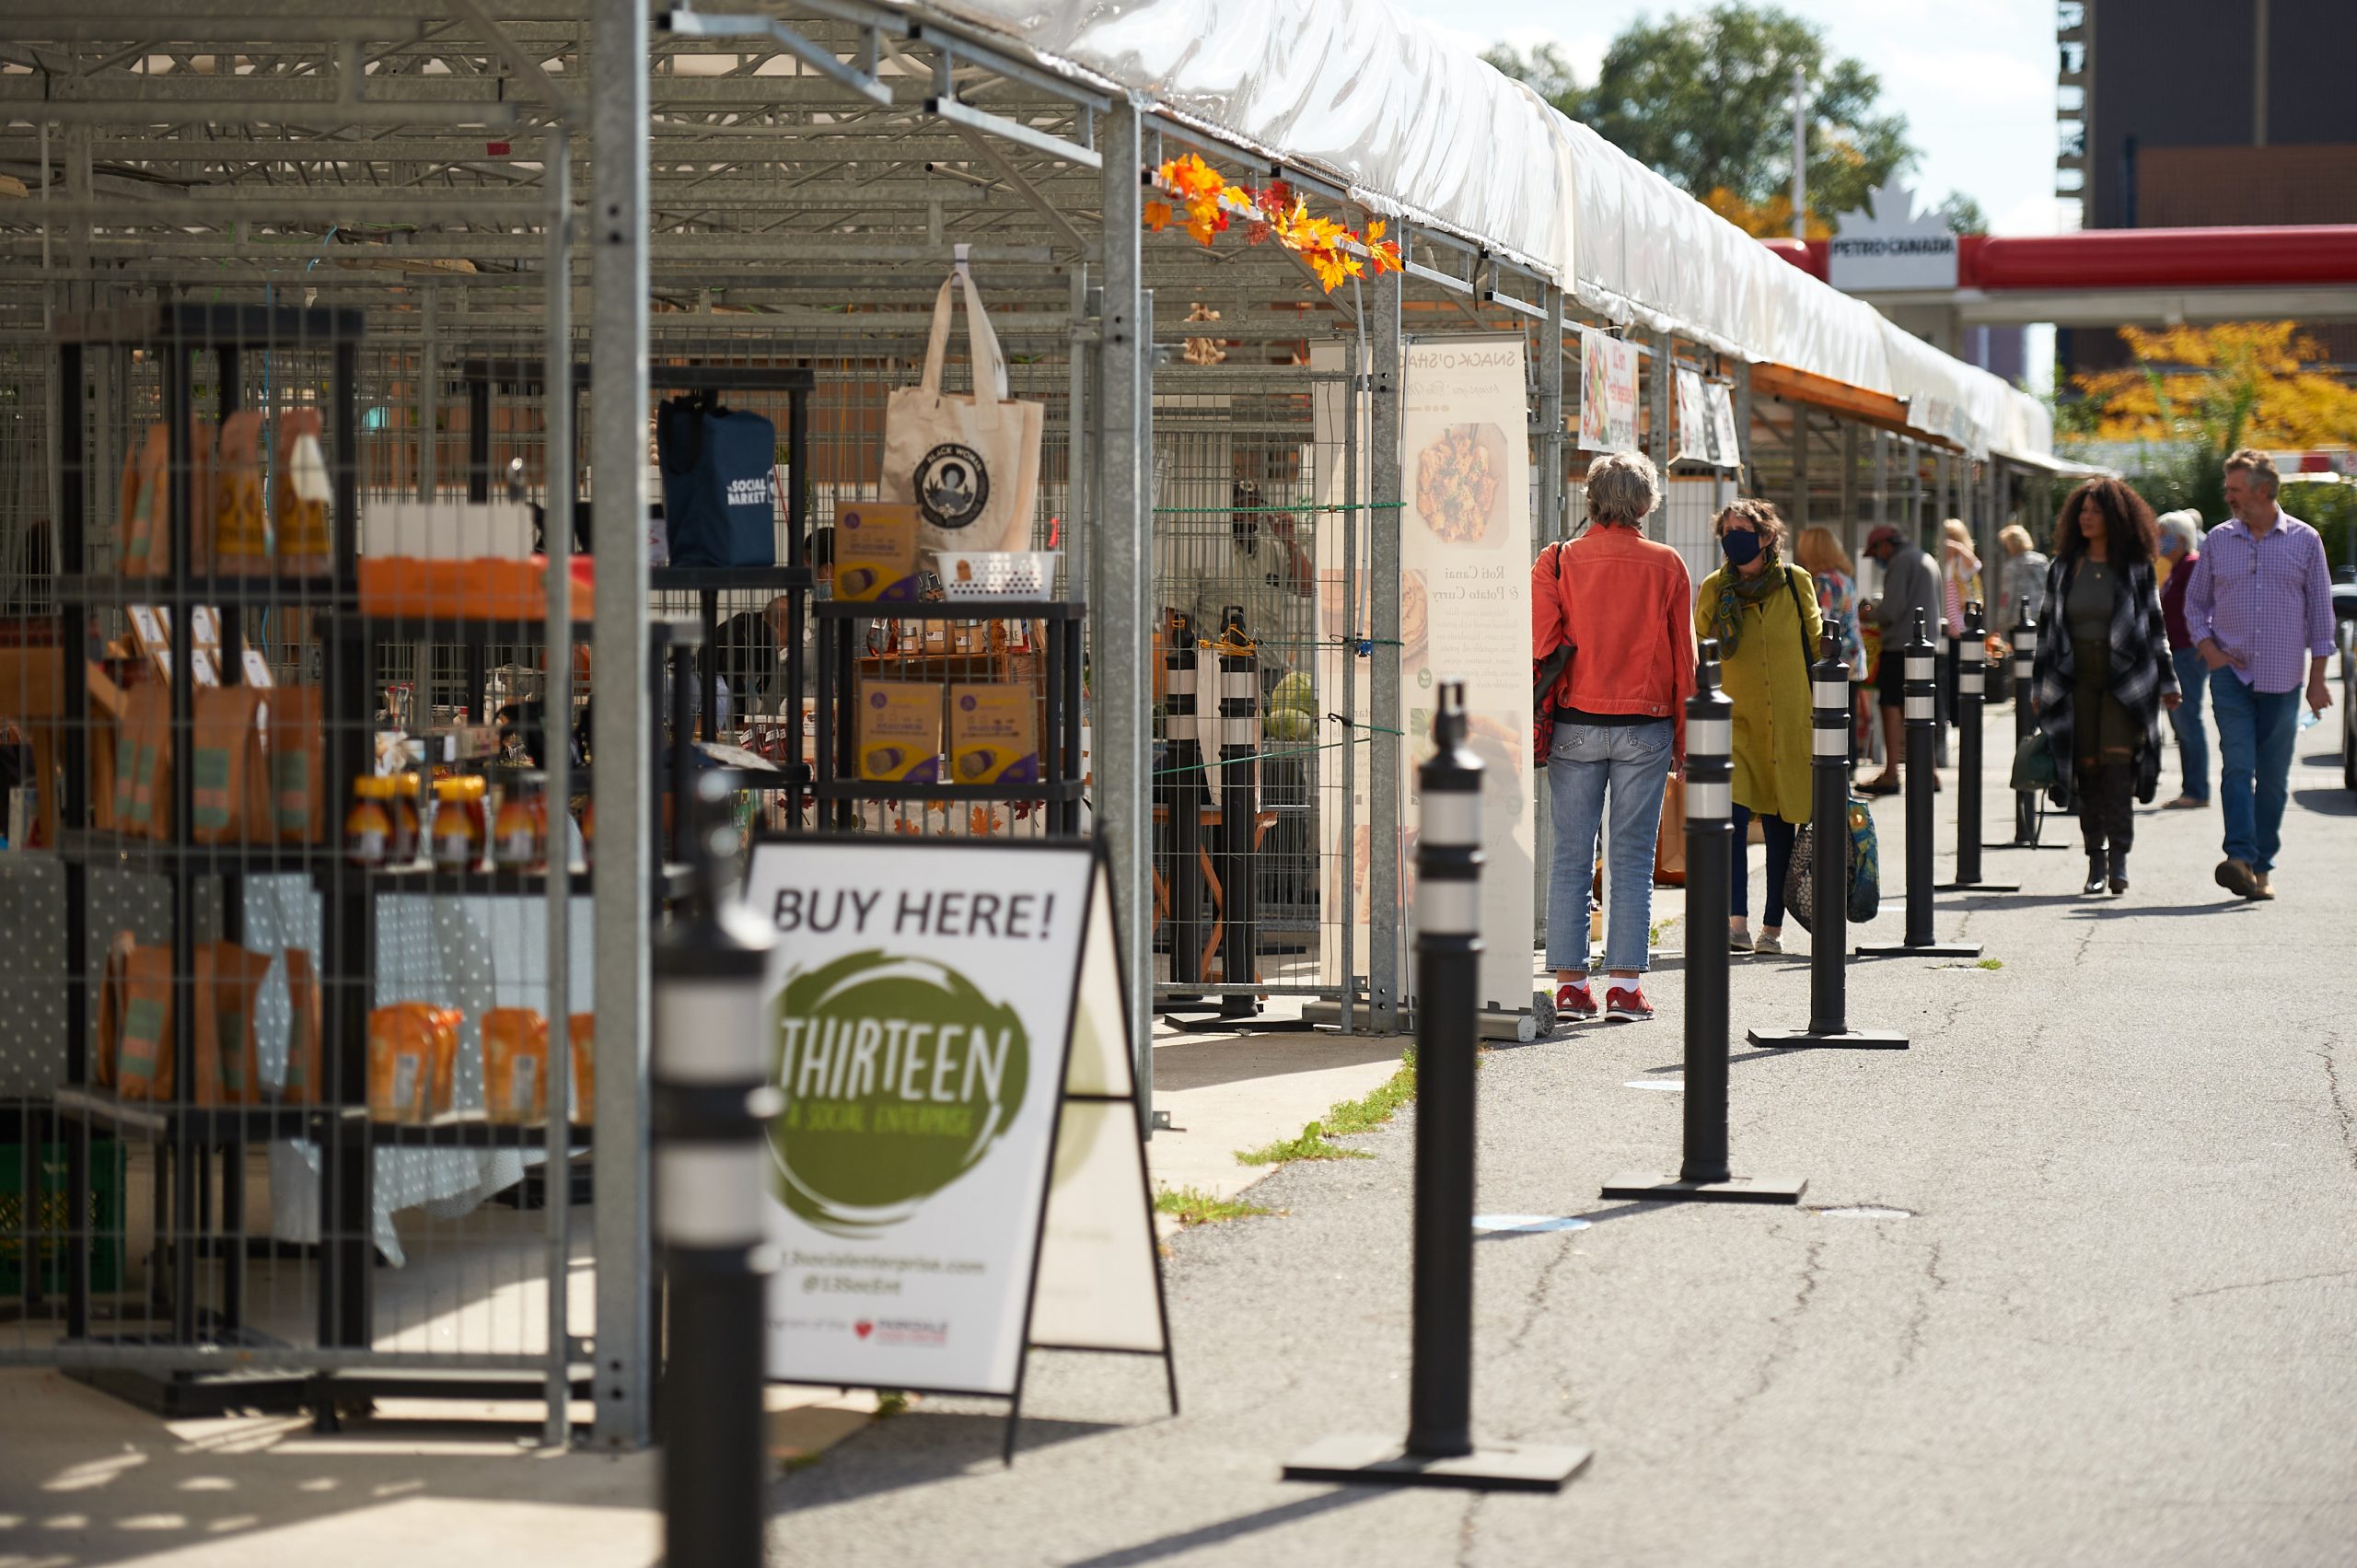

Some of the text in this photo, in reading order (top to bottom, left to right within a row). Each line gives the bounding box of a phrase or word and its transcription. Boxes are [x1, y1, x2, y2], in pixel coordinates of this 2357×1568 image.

[926, 447, 982, 472] BLACK WOMAN
[727, 492, 766, 505] MARKET
[732, 479, 766, 493] SOCIAL
[772, 889, 1056, 940] BUY HERE!
[779, 1016, 1013, 1108] THIRTEEN
[807, 1103, 865, 1133] SOCIAL
[874, 1105, 973, 1137] ENTERPRISE
